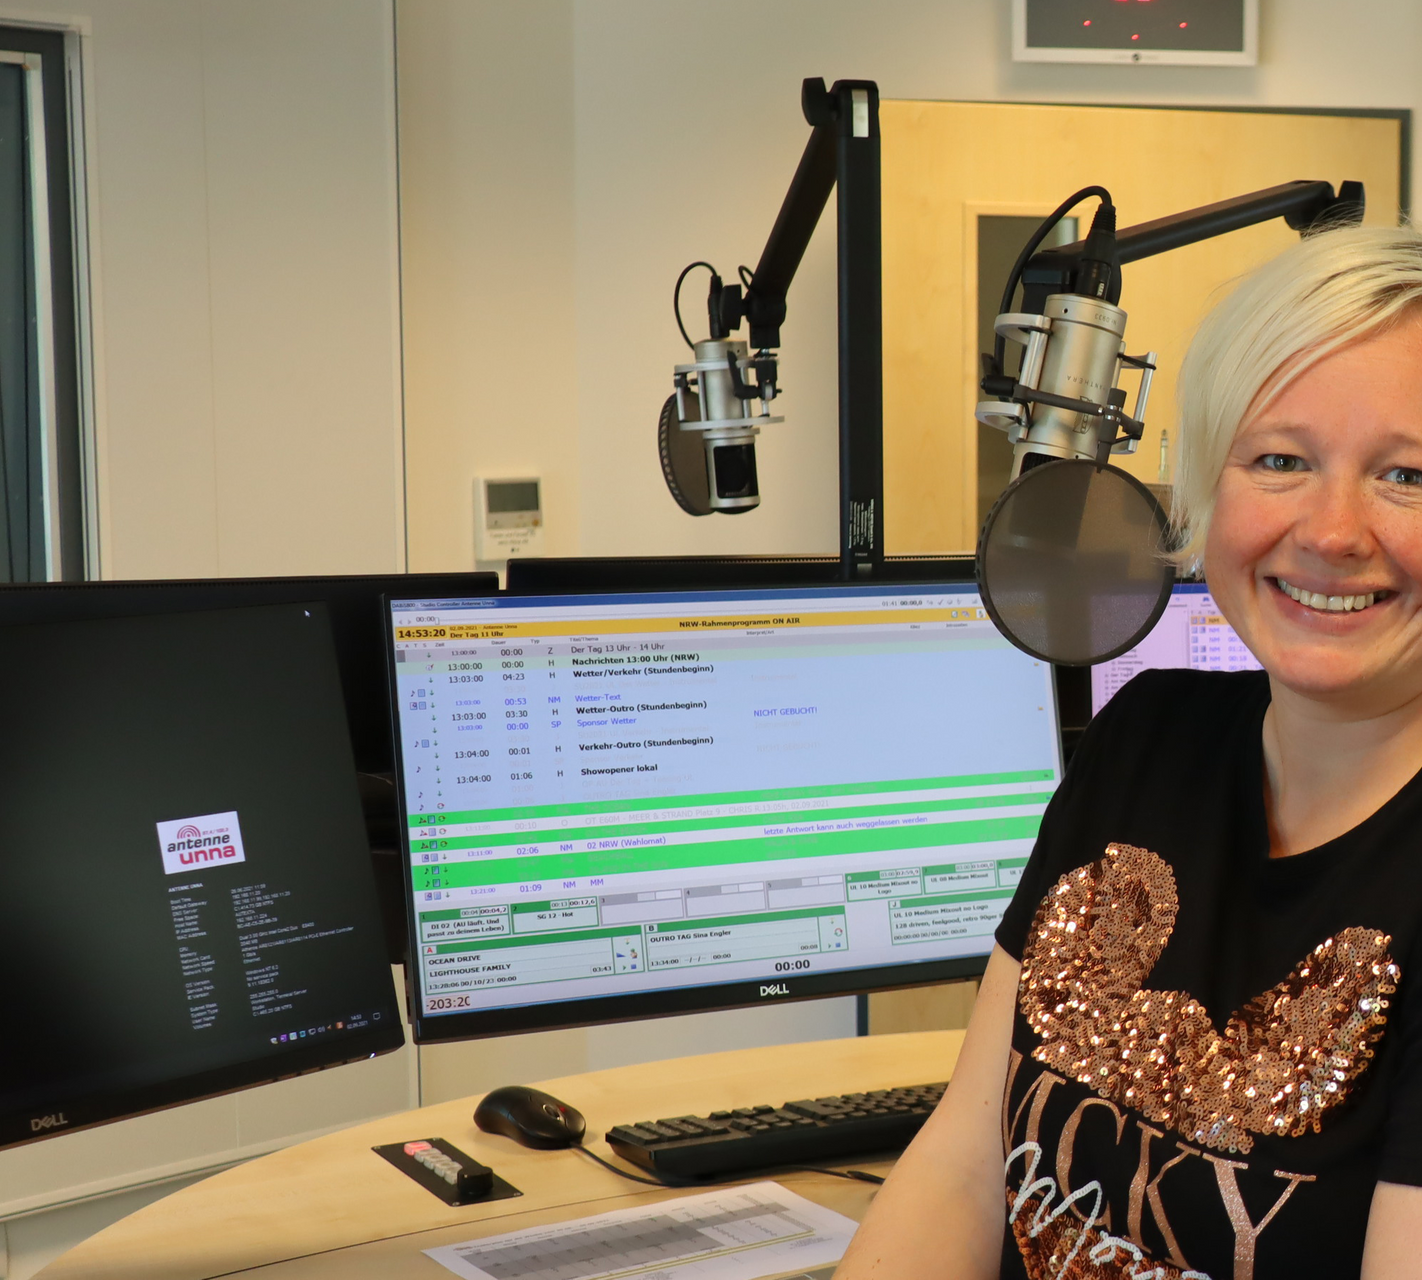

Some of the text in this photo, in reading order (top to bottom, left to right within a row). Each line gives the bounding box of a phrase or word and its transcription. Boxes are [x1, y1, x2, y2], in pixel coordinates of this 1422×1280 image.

[900, 599, 923, 607] 00:00,0
[679, 617, 770, 628] NRW-Rahmenprogramm
[772, 617, 784, 625] ON
[398, 628, 446, 638] 14:53:20
[465, 632, 478, 640] Tag
[571, 645, 585, 653] Der
[587, 645, 602, 654] Tag
[572, 653, 700, 665] Nachrichten 13:00 Uhr (NRW)
[448, 662, 482, 671] 13:00:00
[573, 664, 714, 678] Wetter/Verkehr (Stundenbeginn)
[449, 675, 483, 683] 13:03:00
[502, 673, 525, 681] 04:23
[548, 696, 561, 704] NM
[574, 694, 621, 702] Wetter-Text
[552, 708, 559, 716] H
[576, 701, 707, 714] Wetter-Outro (Stundenbeginn)
[753, 707, 817, 717] NICHT GEBUCHT!
[452, 713, 486, 721] 13:03:00
[505, 710, 528, 718] 03:30
[551, 720, 561, 728] SP
[577, 717, 637, 728] Sponsor Wetter
[579, 736, 714, 751] Verkehr-Outro (Stundenbeginn)
[455, 750, 489, 759] 13:04:00
[581, 764, 658, 776] Showopener lokal
[457, 775, 491, 784] 13:04:00
[510, 772, 533, 780] 01:06
[791, 799, 829, 809] 02.09.2021
[585, 817, 596, 825] OT
[629, 813, 651, 822] MEER
[662, 810, 693, 819] STRAND
[696, 808, 713, 816] Platz
[728, 806, 752, 814] CHRIS
[514, 821, 537, 830] 00:10
[763, 816, 928, 835] letzte Antwort kann auch weggelassen werden
[167, 834, 230, 852] antenne
[587, 836, 667, 849] 02 NRW (Wahlomat)
[516, 846, 539, 855] 02:06
[560, 843, 573, 852] NM
[179, 845, 236, 865] unna
[563, 881, 576, 889] NM
[590, 878, 604, 886] MM
[519, 884, 542, 892] 01:09
[878, 888, 892, 896] Logo
[569, 899, 595, 907] 00:12,6
[480, 907, 507, 915] 00:04,2
[914, 908, 939, 916] Medium
[941, 906, 962, 914] Mixout
[453, 921, 466, 929] (AU
[467, 919, 485, 927] läuft.
[909, 920, 930, 928] driven,
[931, 917, 961, 926] feelgood,
[979, 914, 997, 922] 90ger
[456, 927, 480, 935] deinem
[481, 924, 505, 933] Leben)
[650, 930, 731, 943] OUTRO TAG Sina Engler
[428, 957, 455, 966] OCEAN
[650, 958, 679, 967] 13:34:00
[774, 959, 810, 972] 00:00
[429, 964, 511, 977] LIGHTHOUSE FAMILY
[429, 975, 517, 990] 13:28:06 00:00
[759, 983, 789, 997] DELL
[31, 1112, 68, 1131] DELL
